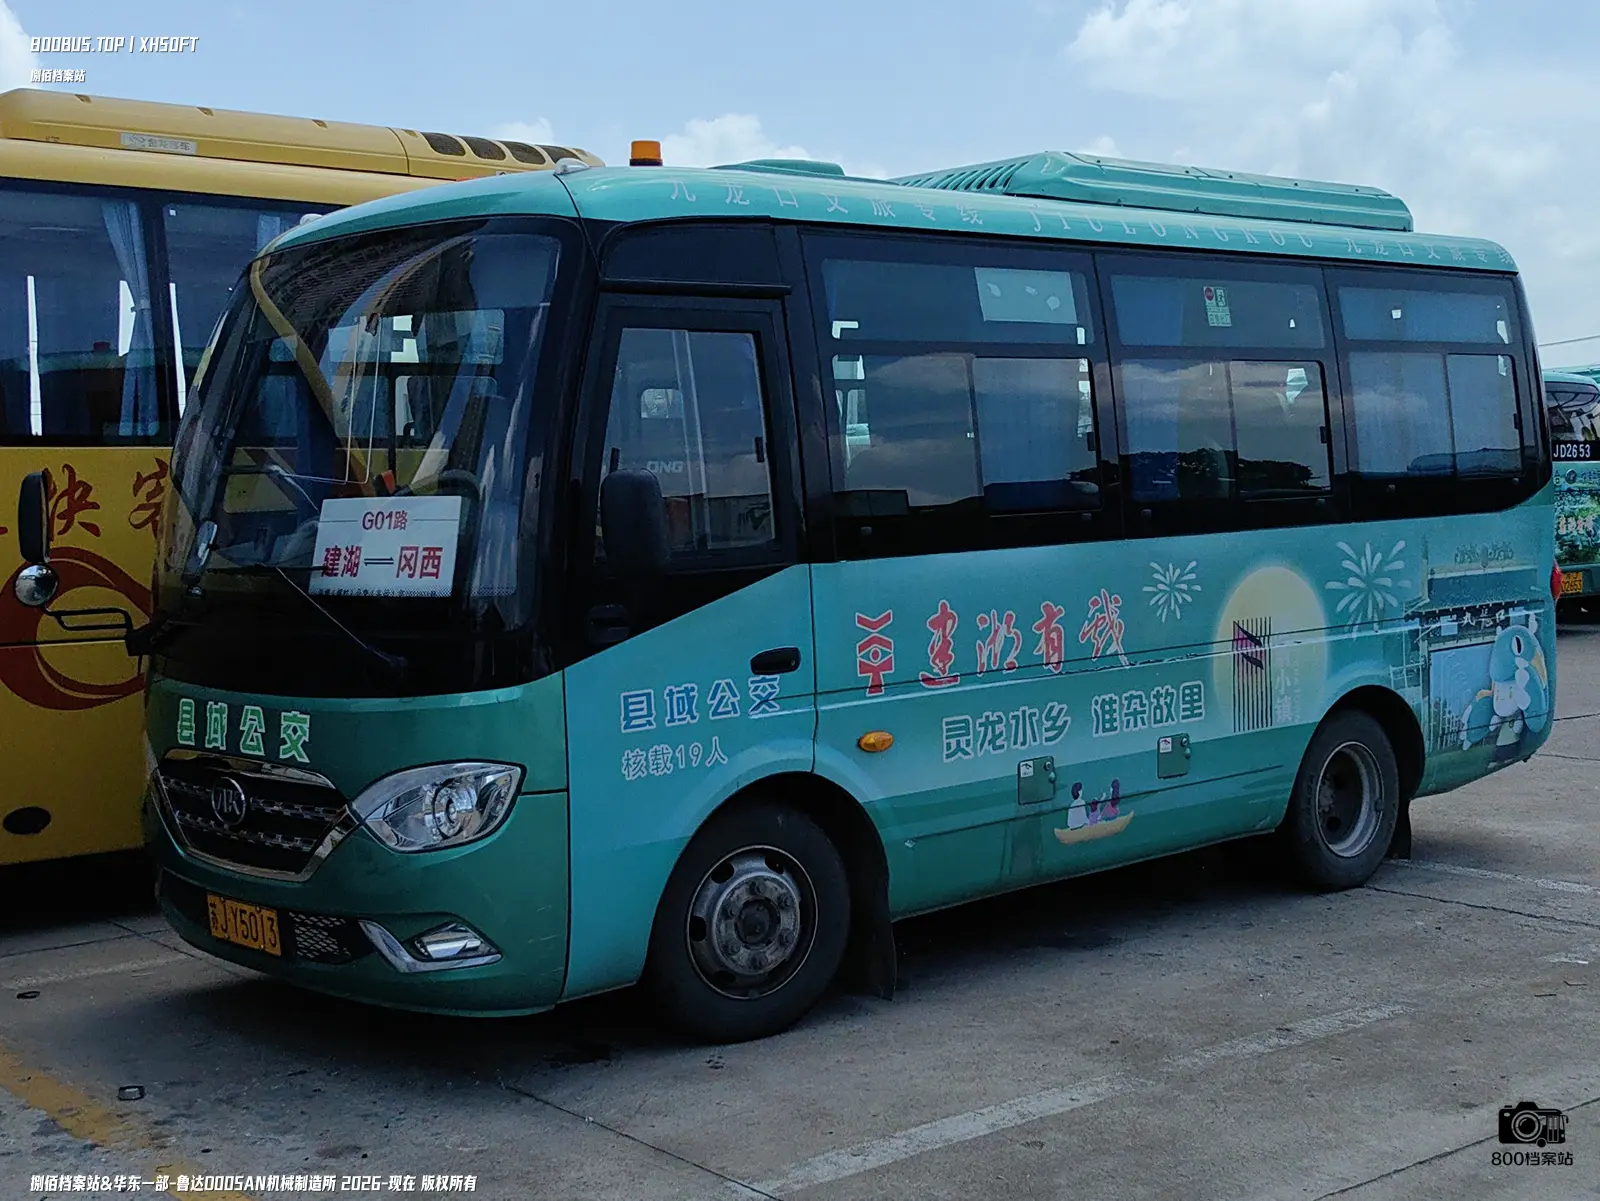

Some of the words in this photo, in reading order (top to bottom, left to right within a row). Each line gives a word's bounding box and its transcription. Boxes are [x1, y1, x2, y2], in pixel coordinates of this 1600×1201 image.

[1553, 443, 1591, 458] JD2653
[362, 510, 408, 531] G01路
[321, 545, 362, 578] 建湖
[396, 545, 443, 579] 冈西
[620, 674, 781, 733] 县域公交
[942, 701, 1071, 762] 灵龙水乡
[1092, 681, 1205, 737] 淮杂故里
[177, 698, 310, 763] 县域公交
[622, 736, 728, 780] 核载19人
